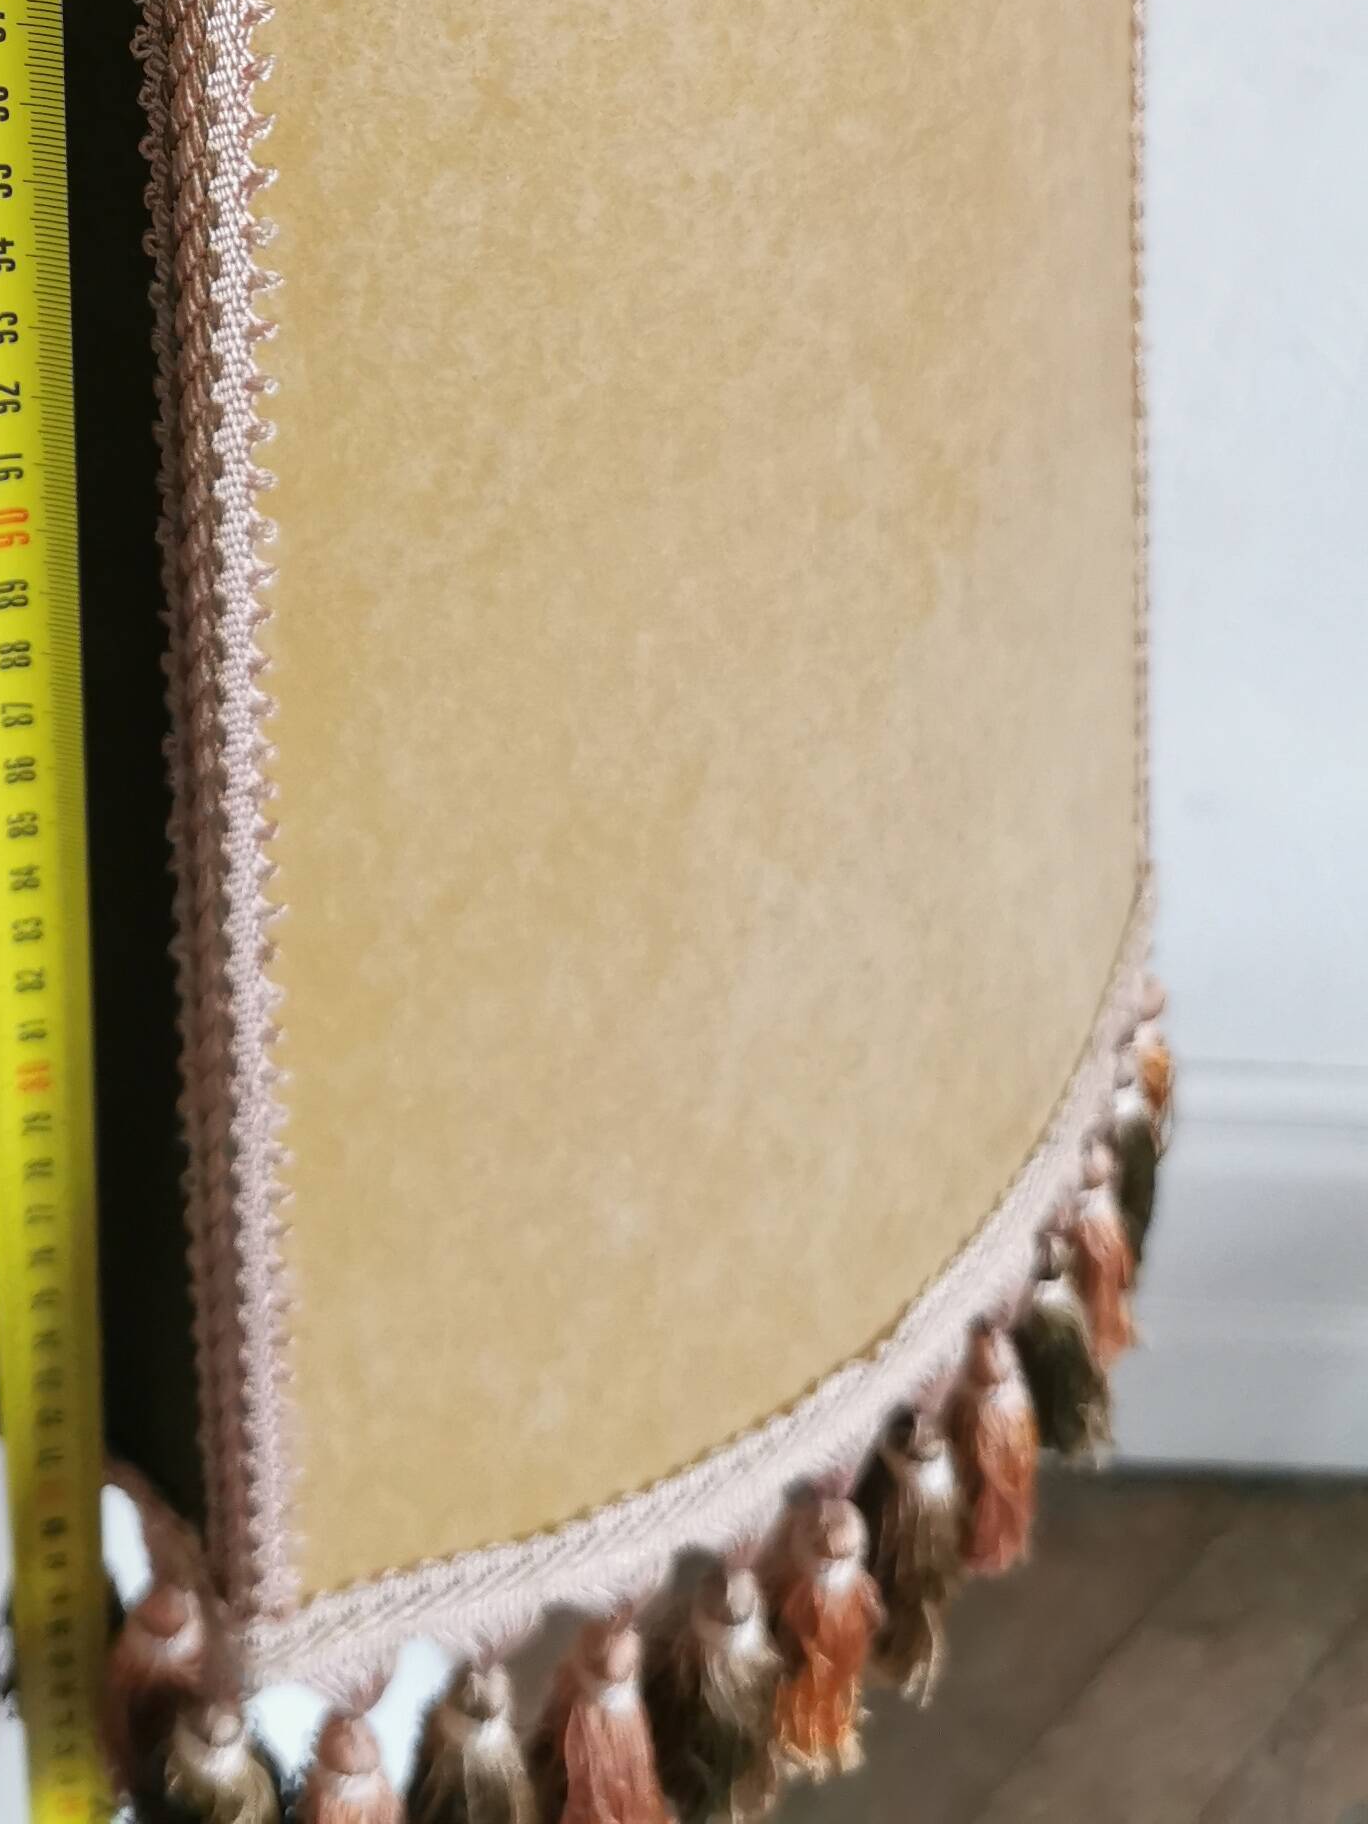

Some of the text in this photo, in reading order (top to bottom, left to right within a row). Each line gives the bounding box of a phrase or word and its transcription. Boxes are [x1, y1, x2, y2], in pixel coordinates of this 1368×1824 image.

[0, 703, 35, 729] 87
[3, 756, 37, 785] 86
[6, 812, 39, 840] 85
[9, 864, 41, 893] 84
[11, 917, 45, 944] 83
